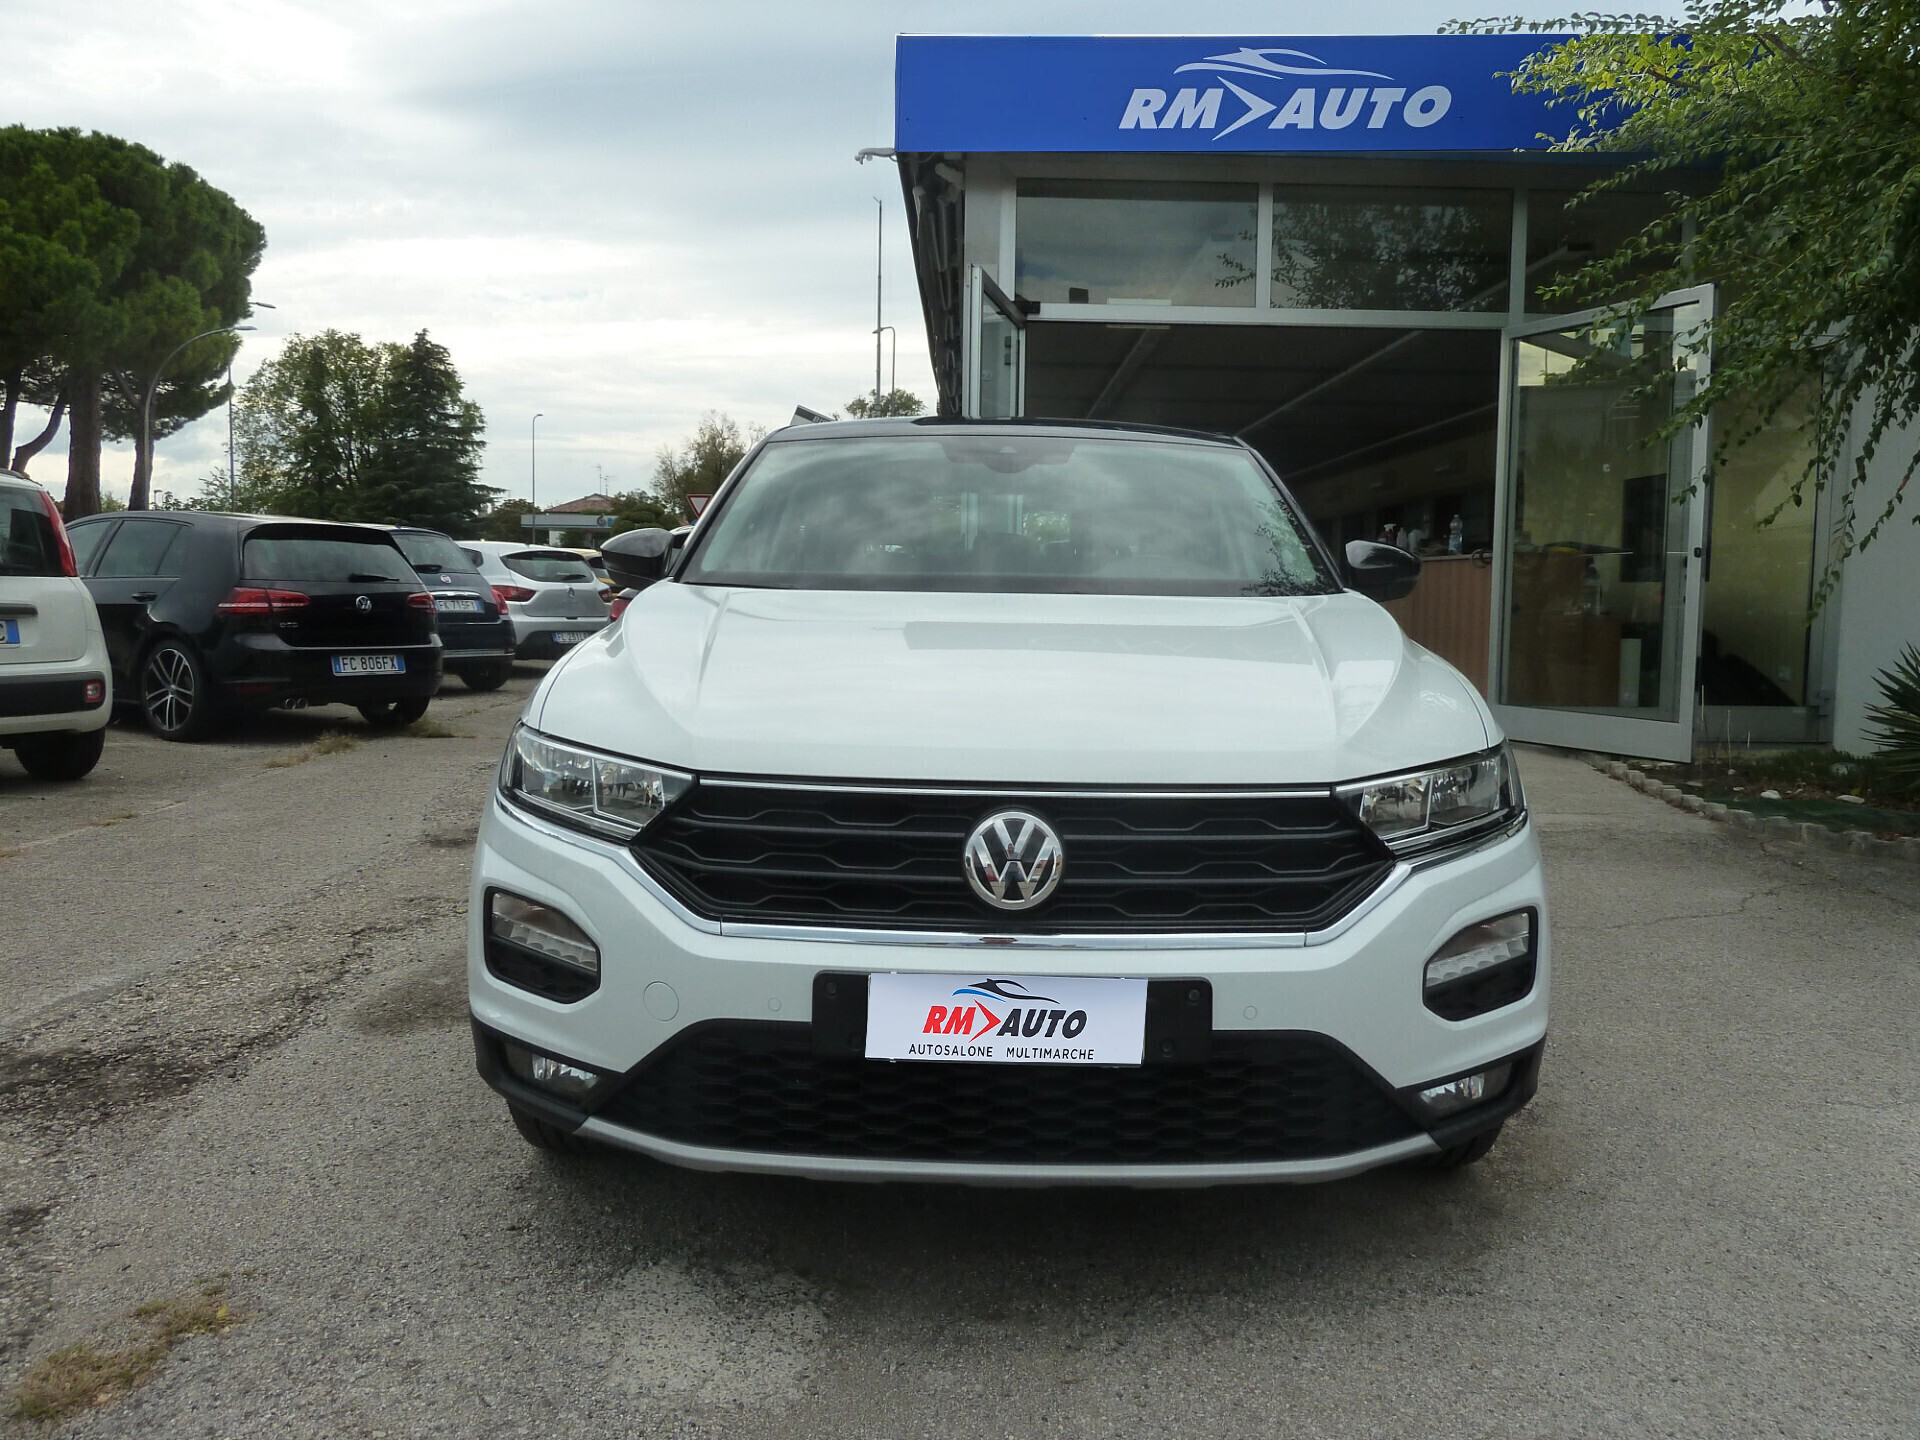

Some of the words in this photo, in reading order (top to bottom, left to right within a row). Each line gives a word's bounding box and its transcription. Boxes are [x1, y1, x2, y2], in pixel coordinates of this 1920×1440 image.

[1118, 88, 1224, 130] RM
[1267, 85, 1453, 130] AUTO
[341, 657, 357, 671] FC
[360, 656, 397, 671] 806FX
[922, 1005, 977, 1035] RM
[996, 1008, 1087, 1039] AUTO
[908, 1043, 994, 1058] AUTOSALONE
[1006, 1046, 1095, 1060] MULTIMARCHE
